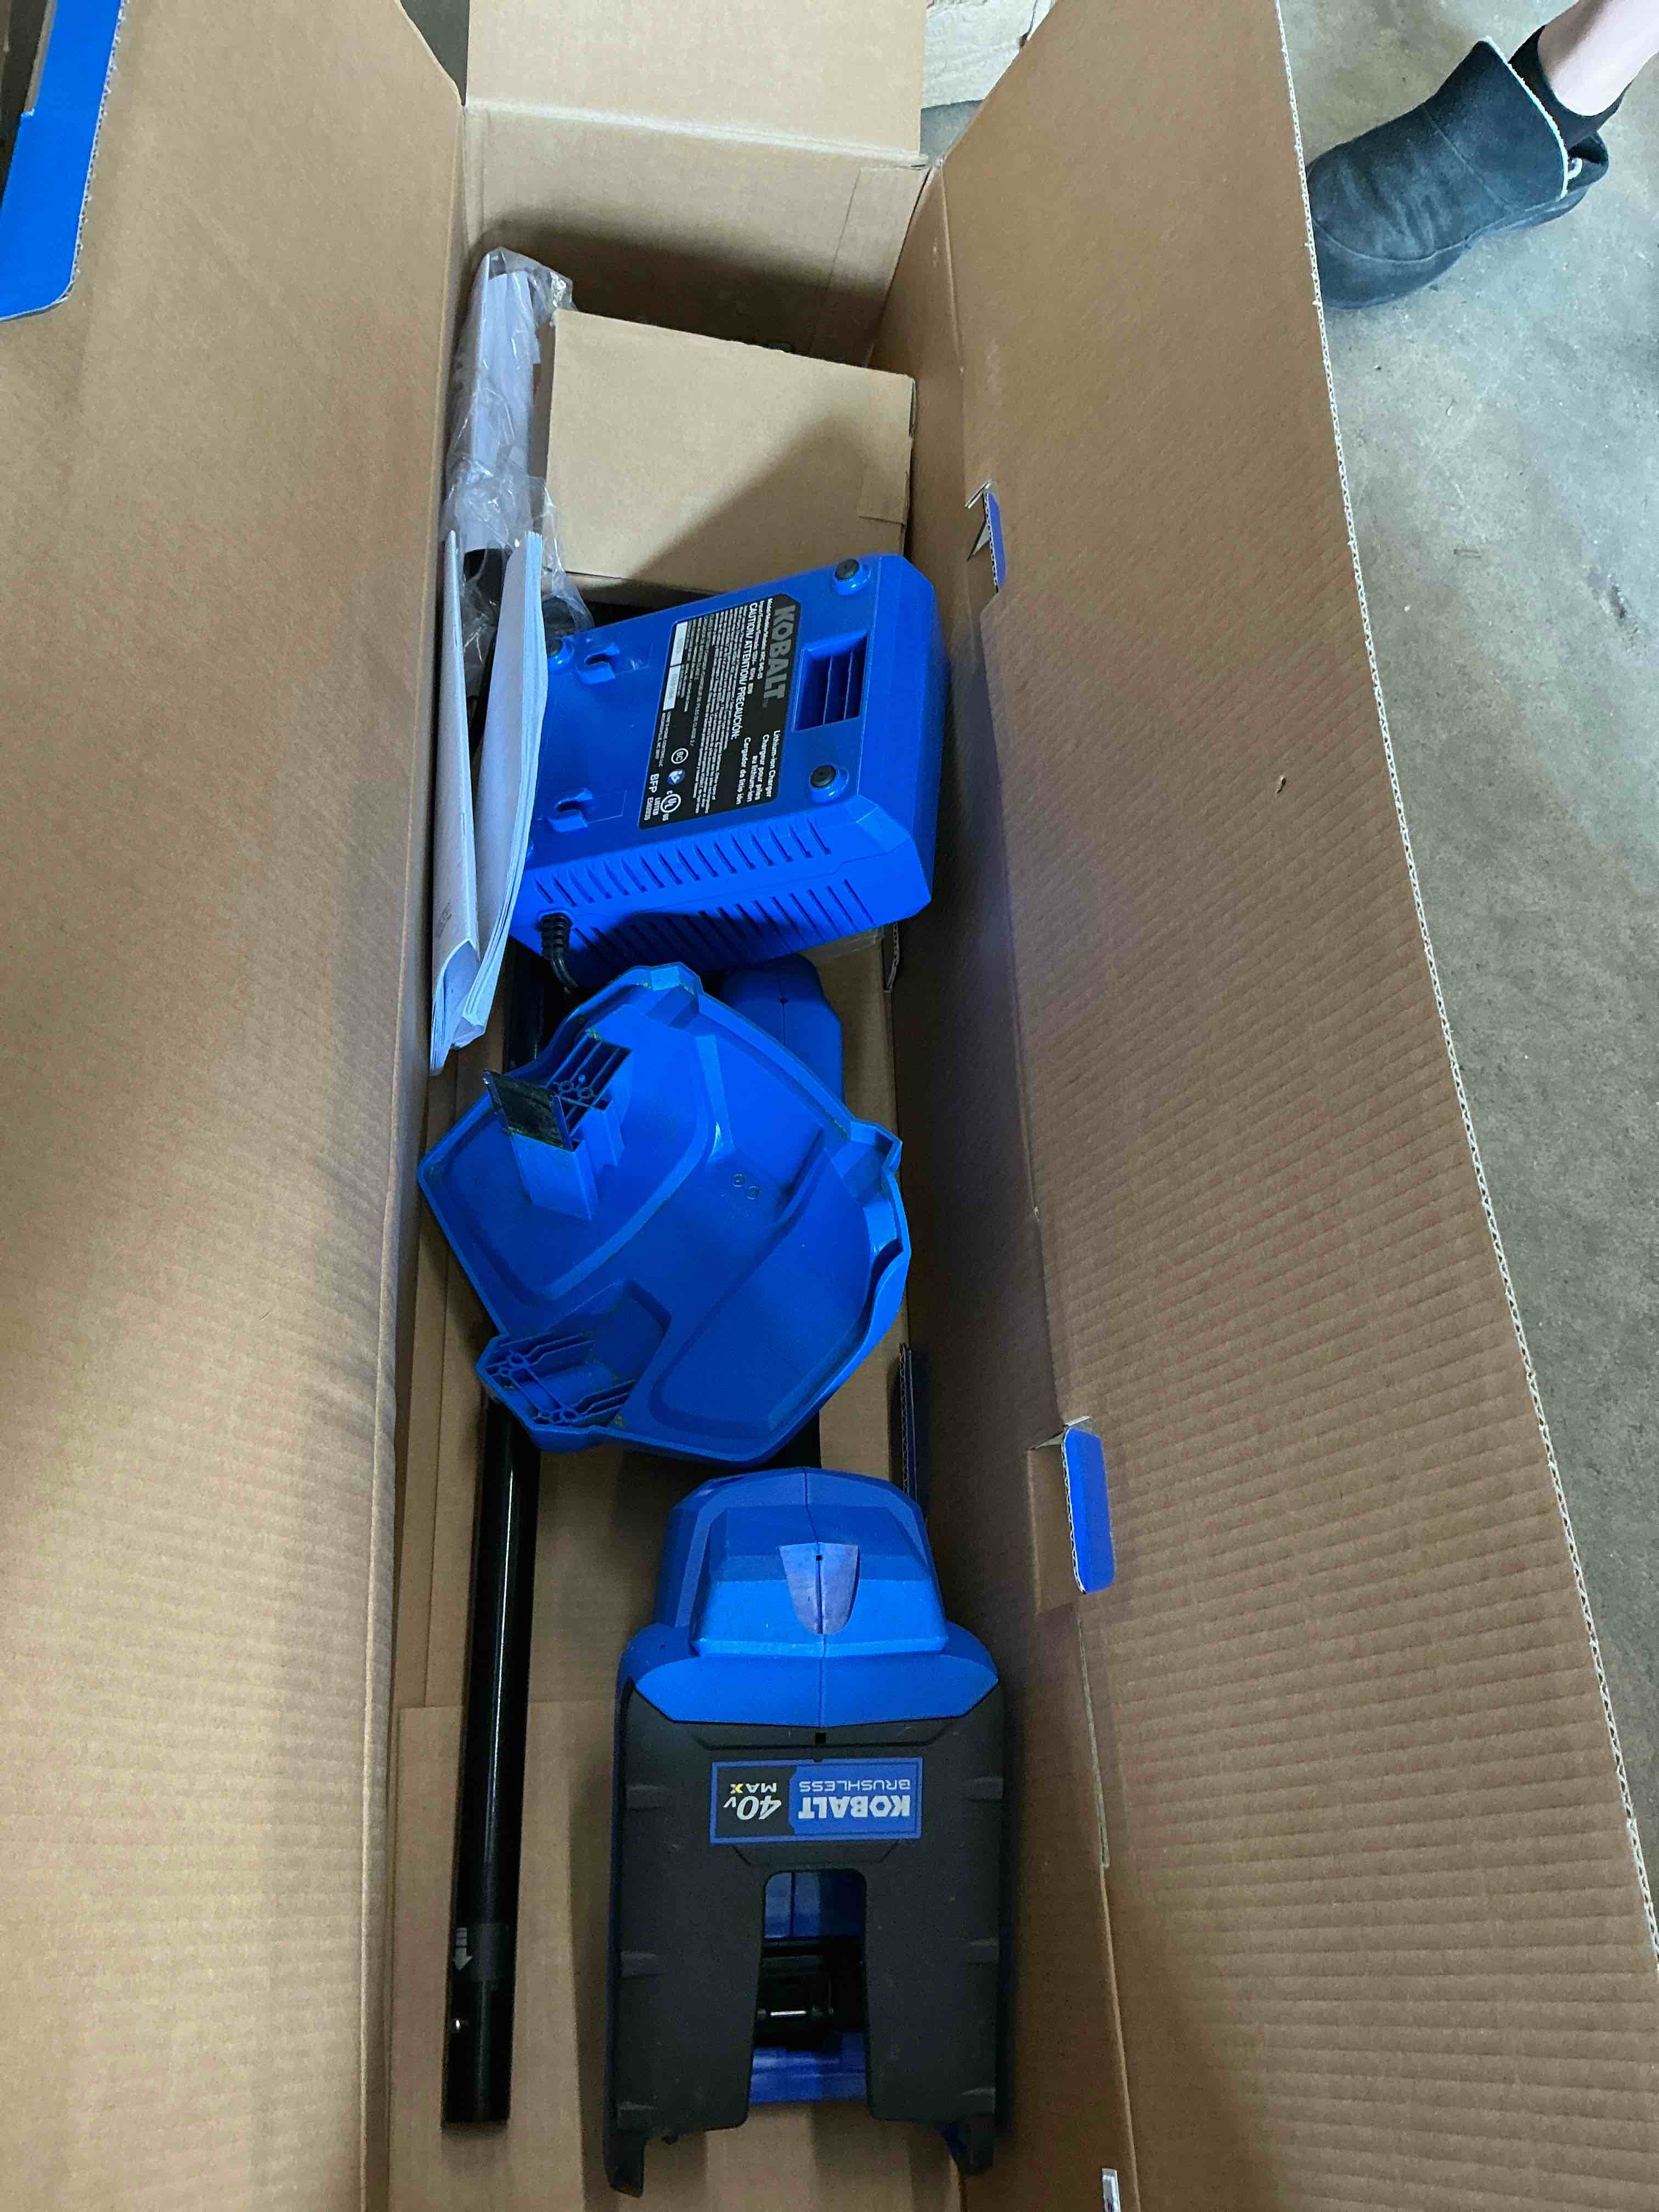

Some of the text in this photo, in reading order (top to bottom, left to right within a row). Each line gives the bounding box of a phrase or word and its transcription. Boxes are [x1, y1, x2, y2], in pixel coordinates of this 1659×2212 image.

[744, 602, 758, 640] CAUTION/
[738, 639, 753, 685] ATTENTION/
[763, 603, 795, 702] KOBALT
[730, 685, 746, 740] PRECAUCIÓN:
[739, 736, 751, 769] Cargador
[753, 733, 769, 801] Chargeur pour piles
[647, 772, 659, 794] BFP
[737, 778, 745, 793] litio
[739, 768, 746, 778] de
[764, 769, 776, 798] Charger
[731, 1779, 910, 1794] BRUSHLESS MAX
[799, 1795, 910, 1819] KOBALT
